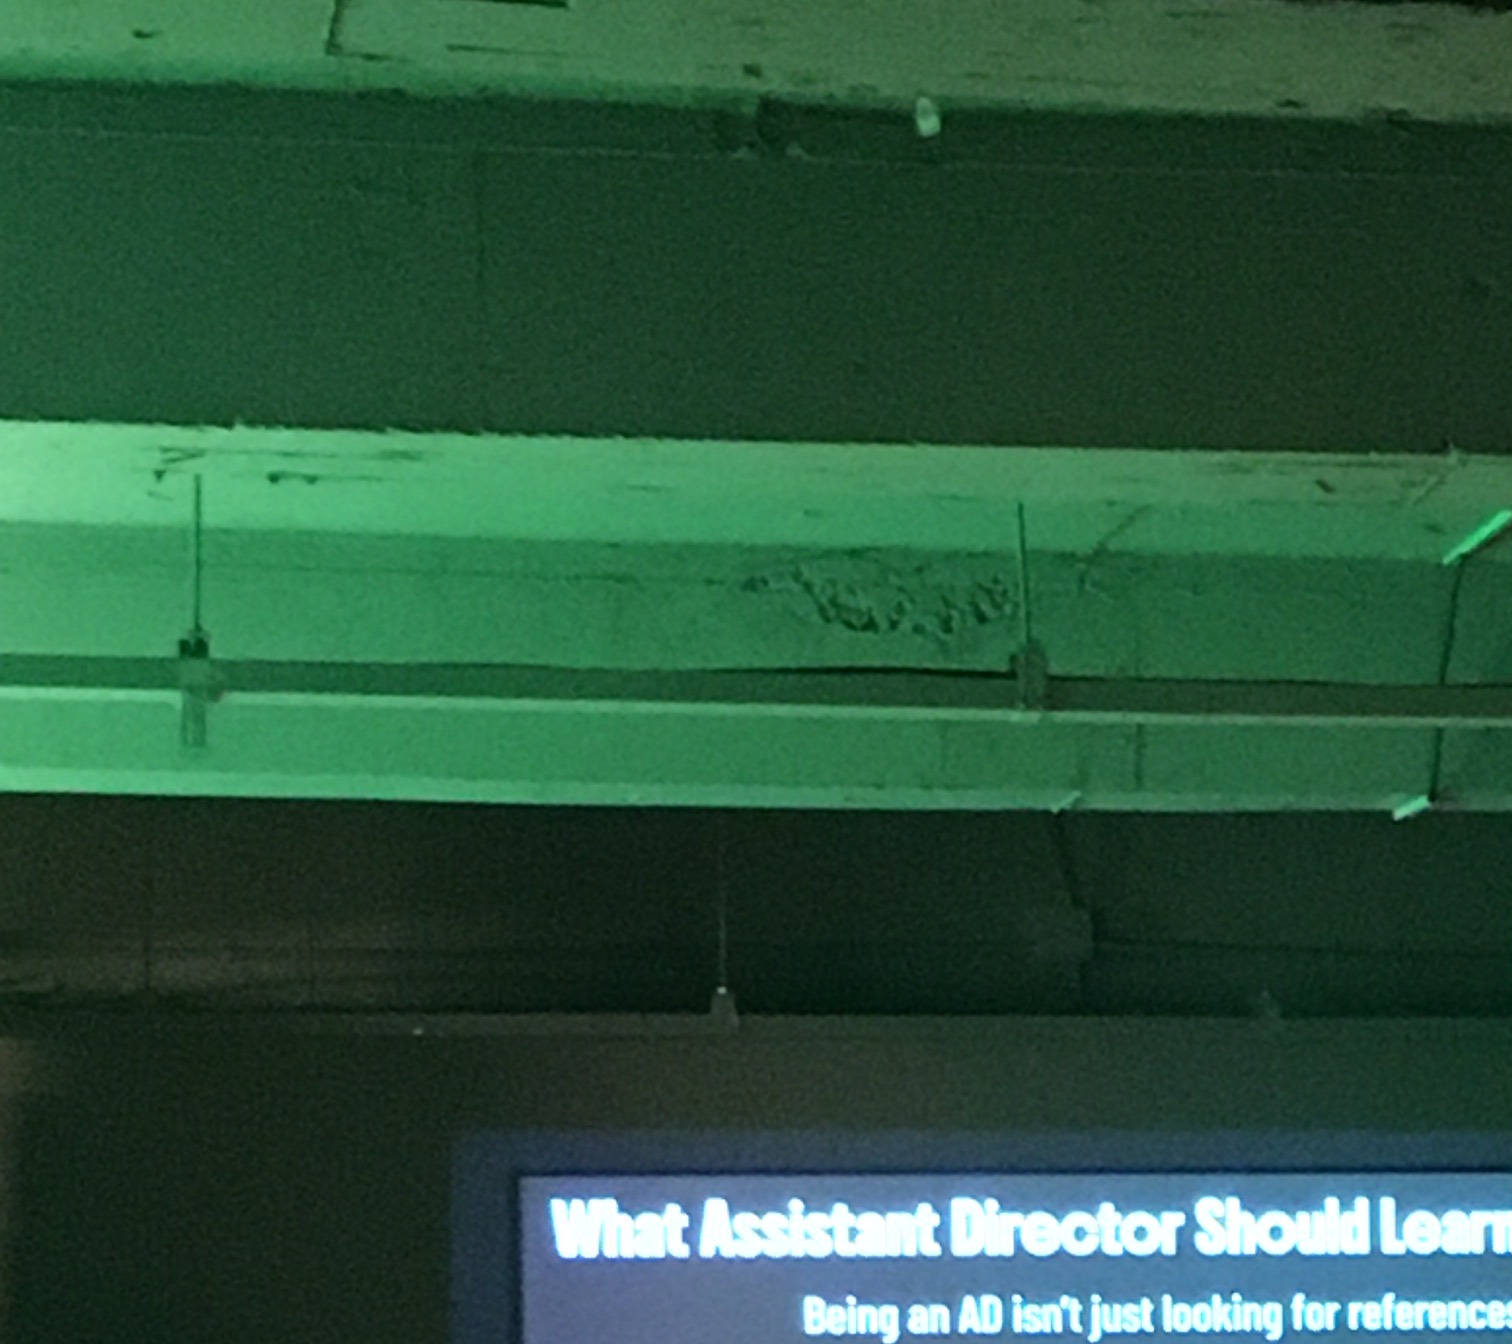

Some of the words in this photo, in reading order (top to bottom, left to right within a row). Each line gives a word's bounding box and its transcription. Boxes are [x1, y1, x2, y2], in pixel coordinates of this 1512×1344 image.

[550, 1197, 691, 1259] What
[698, 1197, 942, 1259] Assistant
[950, 1196, 1186, 1257] Director
[1194, 1196, 1371, 1256] Should
[802, 1294, 900, 1344] Being
[906, 1304, 951, 1335] an
[958, 1294, 1003, 1334] AD
[1011, 1294, 1083, 1333] isn't
[1087, 1294, 1155, 1343] just
[1161, 1292, 1283, 1341] looking
[1290, 1292, 1342, 1332] for
